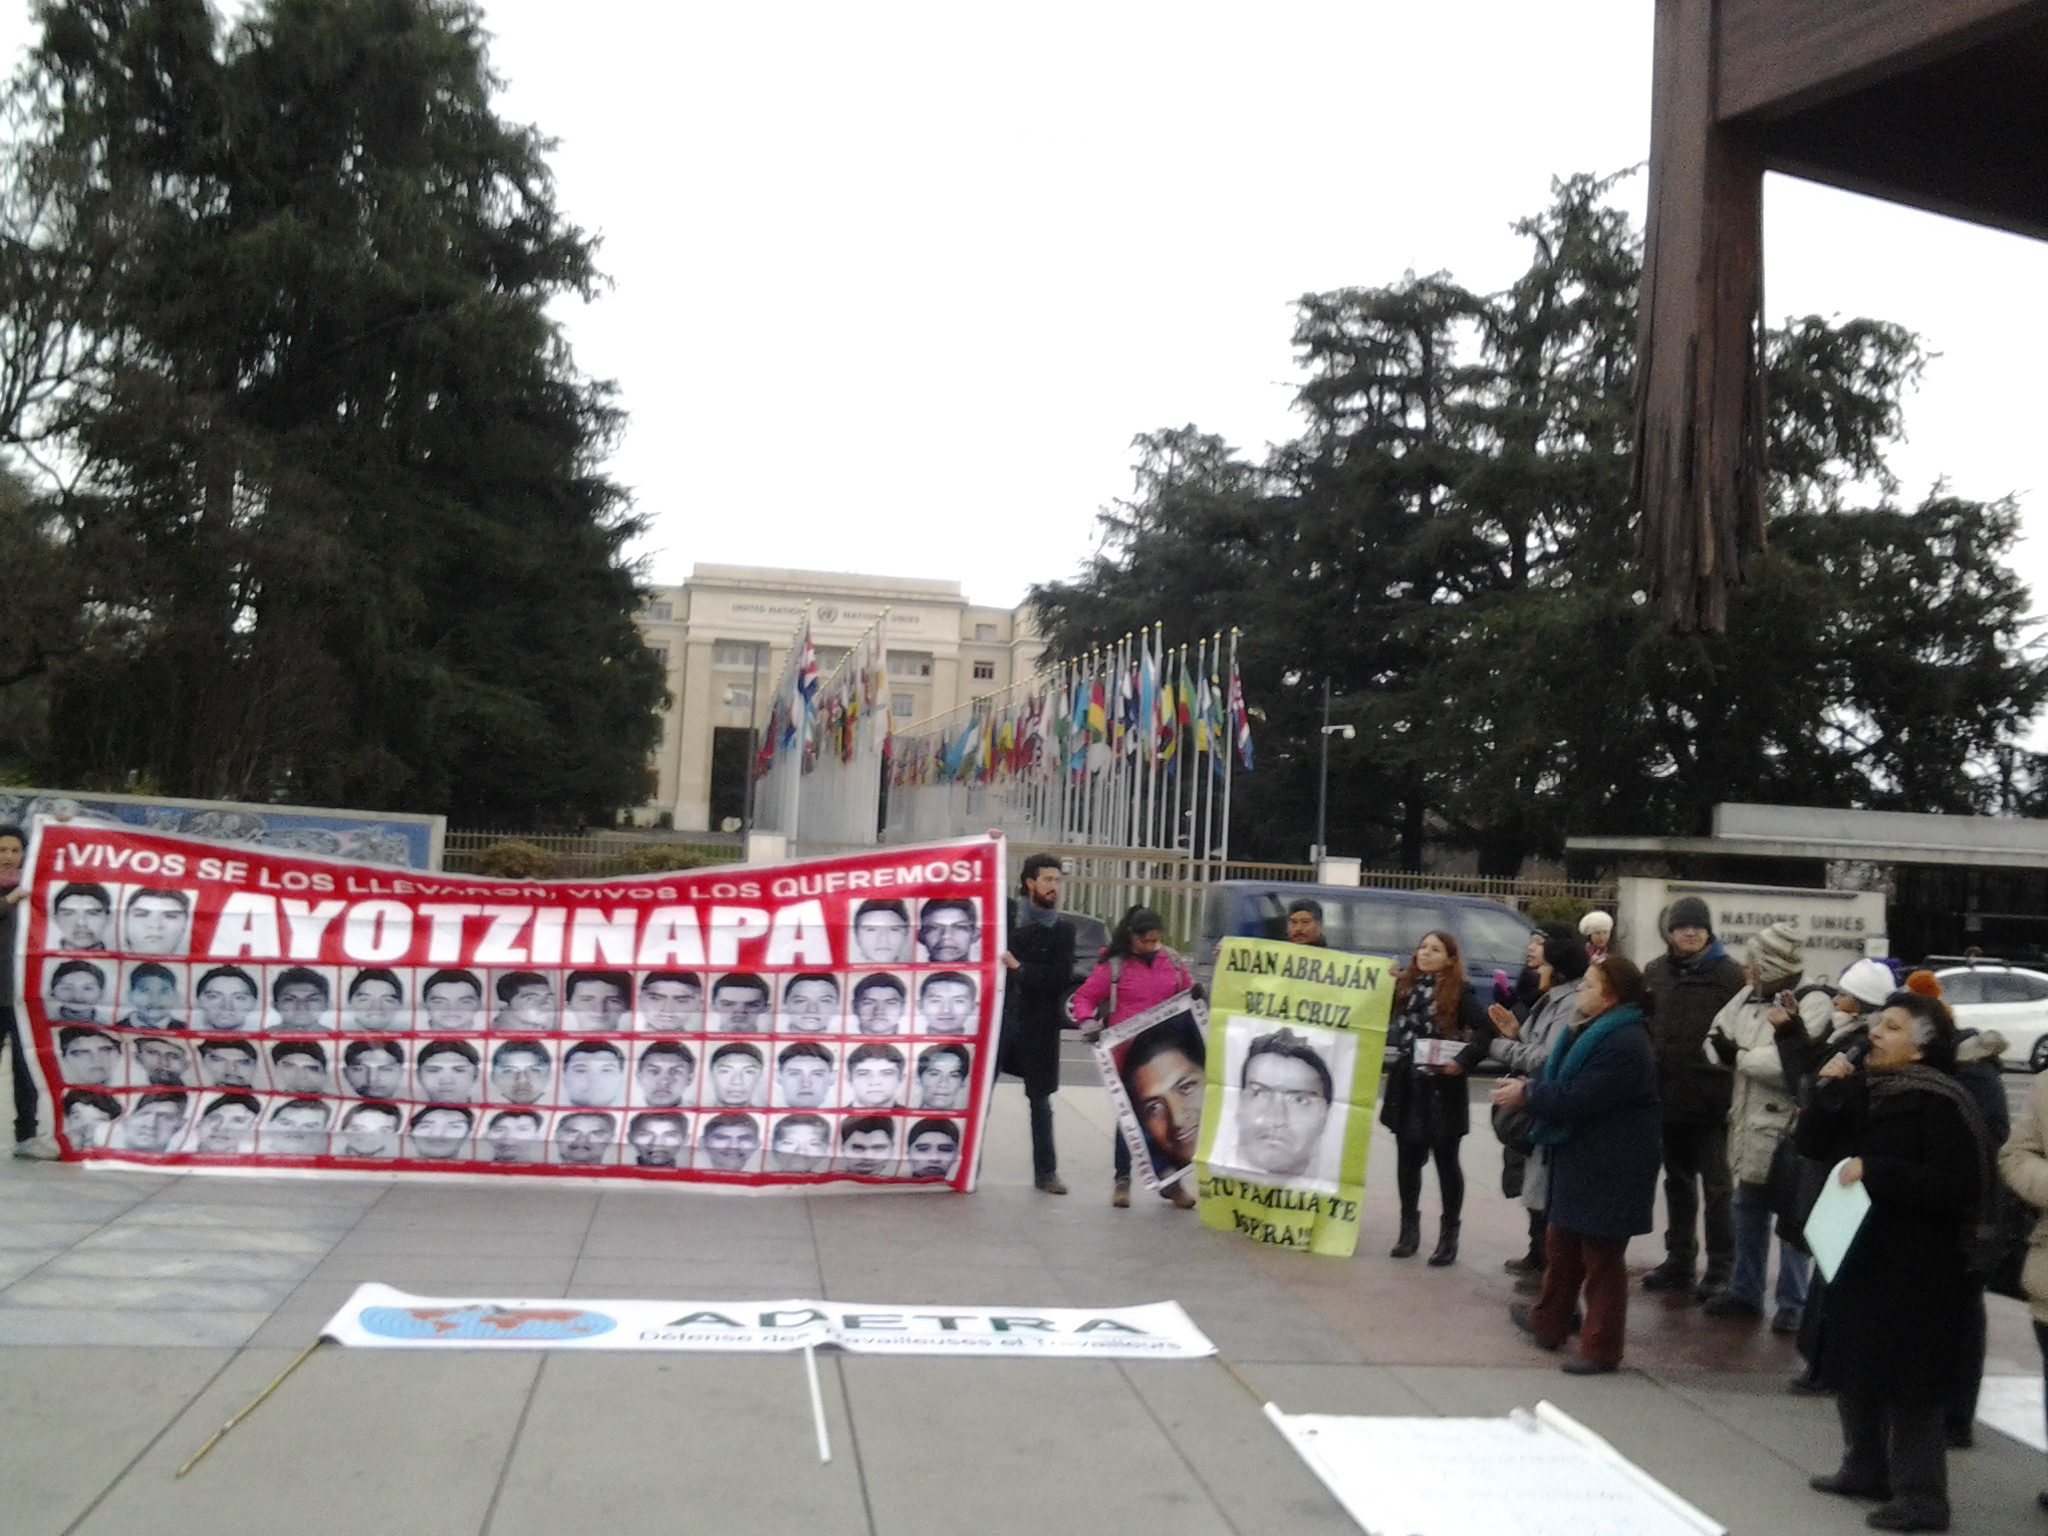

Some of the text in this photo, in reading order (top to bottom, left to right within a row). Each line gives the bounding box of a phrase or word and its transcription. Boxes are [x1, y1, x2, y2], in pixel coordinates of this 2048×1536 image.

[53, 842, 187, 877] ¡VIVOS
[197, 857, 249, 884] SE
[259, 866, 336, 892] LOS
[567, 881, 678, 900] VIVOS
[690, 881, 762, 900] LOS
[208, 892, 834, 967] AYOTZINAPA
[1811, 914, 1865, 932] UNIES
[1805, 934, 1866, 954] ATIONS
[1280, 953, 1381, 992] ABRAJÁN
[1265, 992, 1291, 1020] LA
[1295, 998, 1352, 1030] CRUZ
[1239, 1181, 1320, 1214] FAMILIA
[1328, 1196, 1359, 1223] TE
[665, 1307, 1150, 1334] ADETRA
